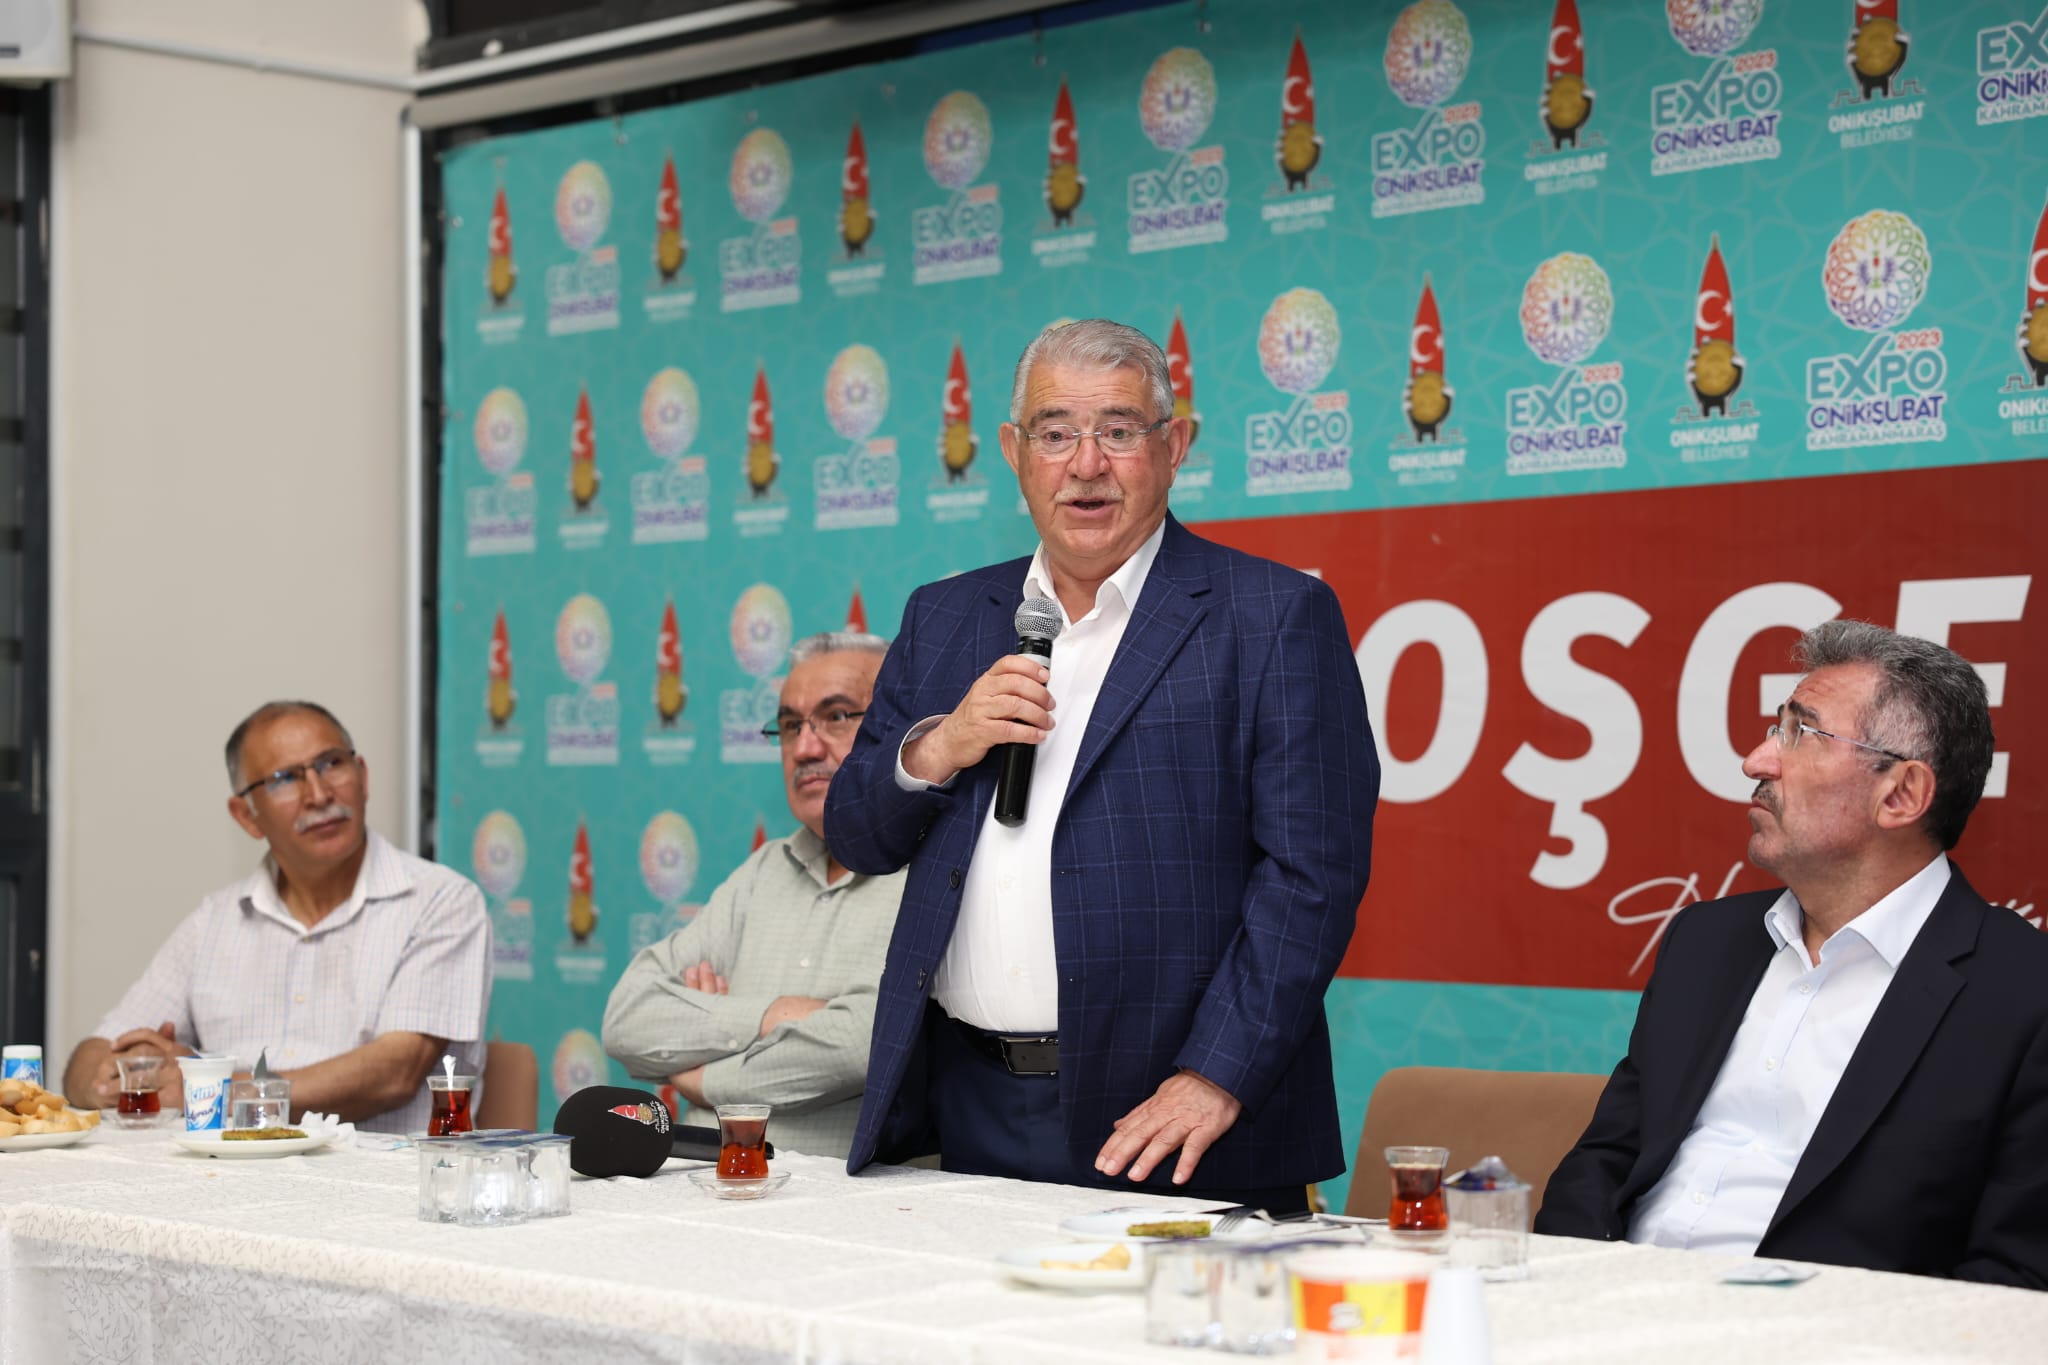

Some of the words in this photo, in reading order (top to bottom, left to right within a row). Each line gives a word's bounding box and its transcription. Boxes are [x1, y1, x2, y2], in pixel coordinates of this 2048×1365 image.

[1734, 50, 1777, 73] 2023
[1653, 58, 1780, 127] EXPO
[1374, 109, 1482, 171] EXPO
[1132, 154, 1225, 210] EXPO
[1810, 334, 1944, 401] EXPO
[1896, 329, 1942, 351] 2023
[1250, 399, 1349, 451] EXPO
[1510, 368, 1624, 429] EXPO
[1300, 568, 2031, 890] OŞGE
